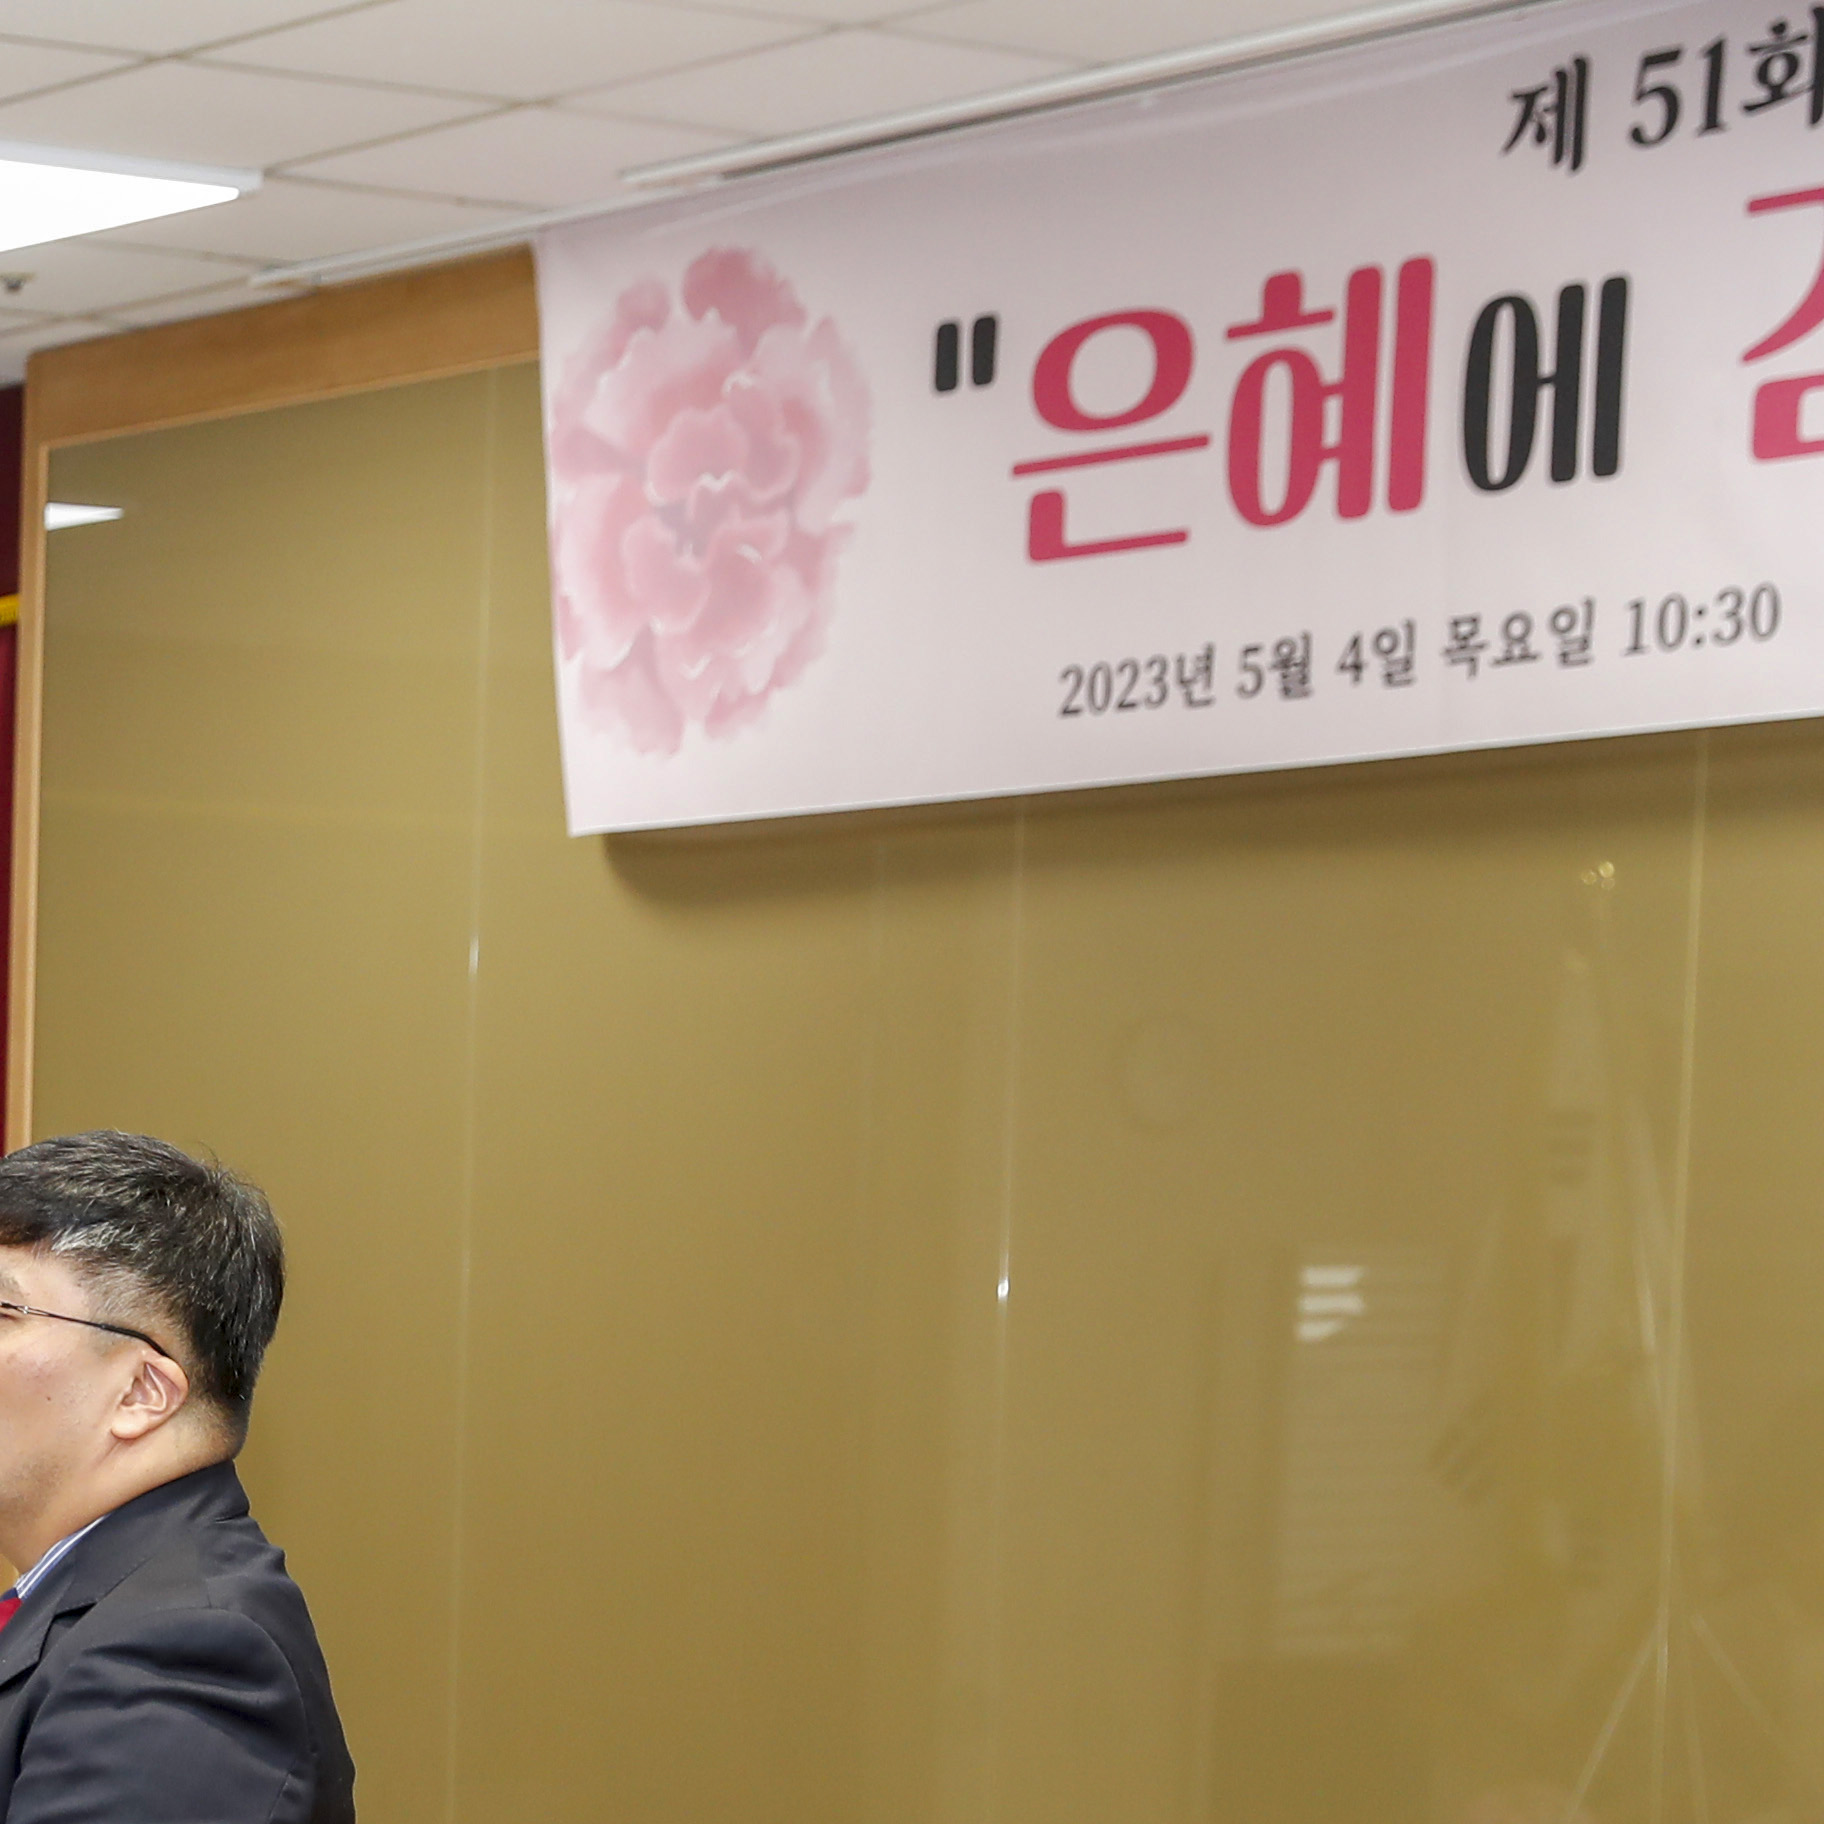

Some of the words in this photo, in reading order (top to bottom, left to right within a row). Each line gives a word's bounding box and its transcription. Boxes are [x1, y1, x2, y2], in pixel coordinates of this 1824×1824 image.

[1502, 55, 1588, 172] 제
[1630, 5, 1824, 144] 51회
[934, 255, 1628, 564] "은혜에
[1058, 641, 1215, 717] 2023년
[1235, 629, 1313, 700] 5월
[1336, 616, 1416, 688] 4일
[1443, 596, 1595, 680] 목요일
[1623, 583, 1780, 656] 10:30
